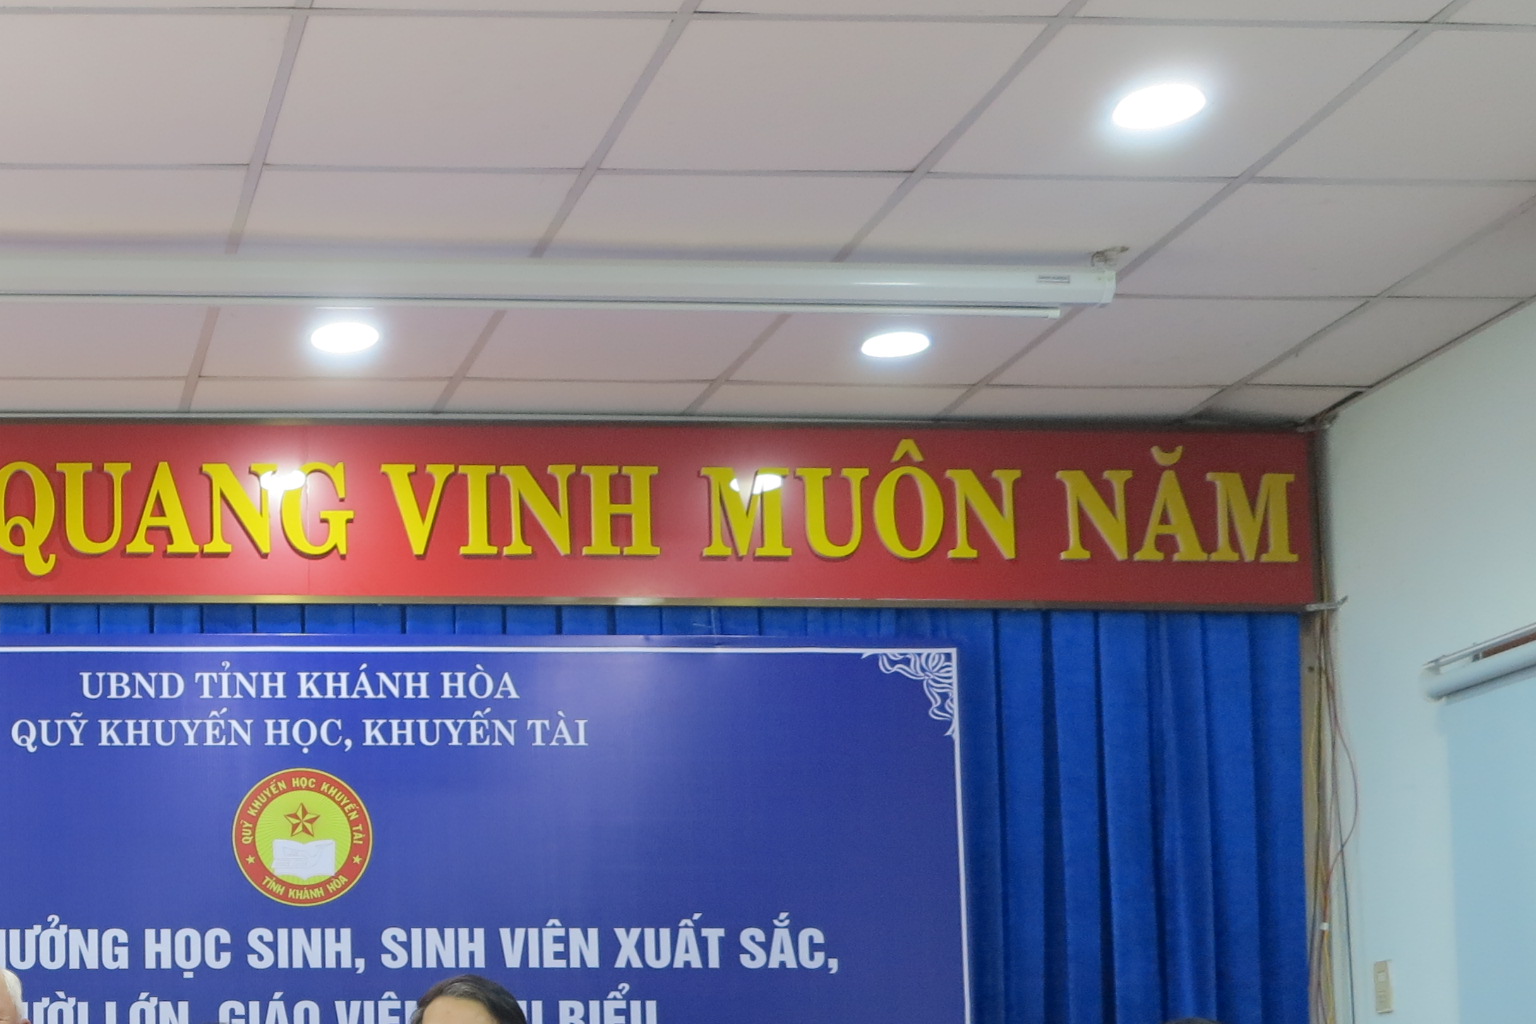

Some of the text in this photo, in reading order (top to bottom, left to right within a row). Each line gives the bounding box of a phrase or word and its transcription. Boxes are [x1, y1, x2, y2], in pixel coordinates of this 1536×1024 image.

[380, 463, 660, 559] VINH
[699, 438, 1021, 560] MUÔN
[1057, 444, 1299, 563] NĂM
[79, 661, 520, 699] UBND TỈNH KHÁNH HÒA
[10, 707, 589, 754] QUỸ KHUYẾN HỌC, KHUYẾN TÀI
[247, 779, 287, 817] KHUYẾN
[291, 777, 316, 789] HỌC
[320, 781, 360, 821] KHUYẾN
[351, 823, 364, 845] TÀI
[288, 886, 325, 900] KHÁNH
[326, 874, 349, 893] HÒA
[145, 927, 232, 978] HỌC
[247, 927, 366, 974] SINH,
[380, 927, 494, 970] SINH
[501, 919, 603, 969] VIÊN
[613, 913, 726, 969] XUẤT
[738, 912, 840, 974] SẮC,
